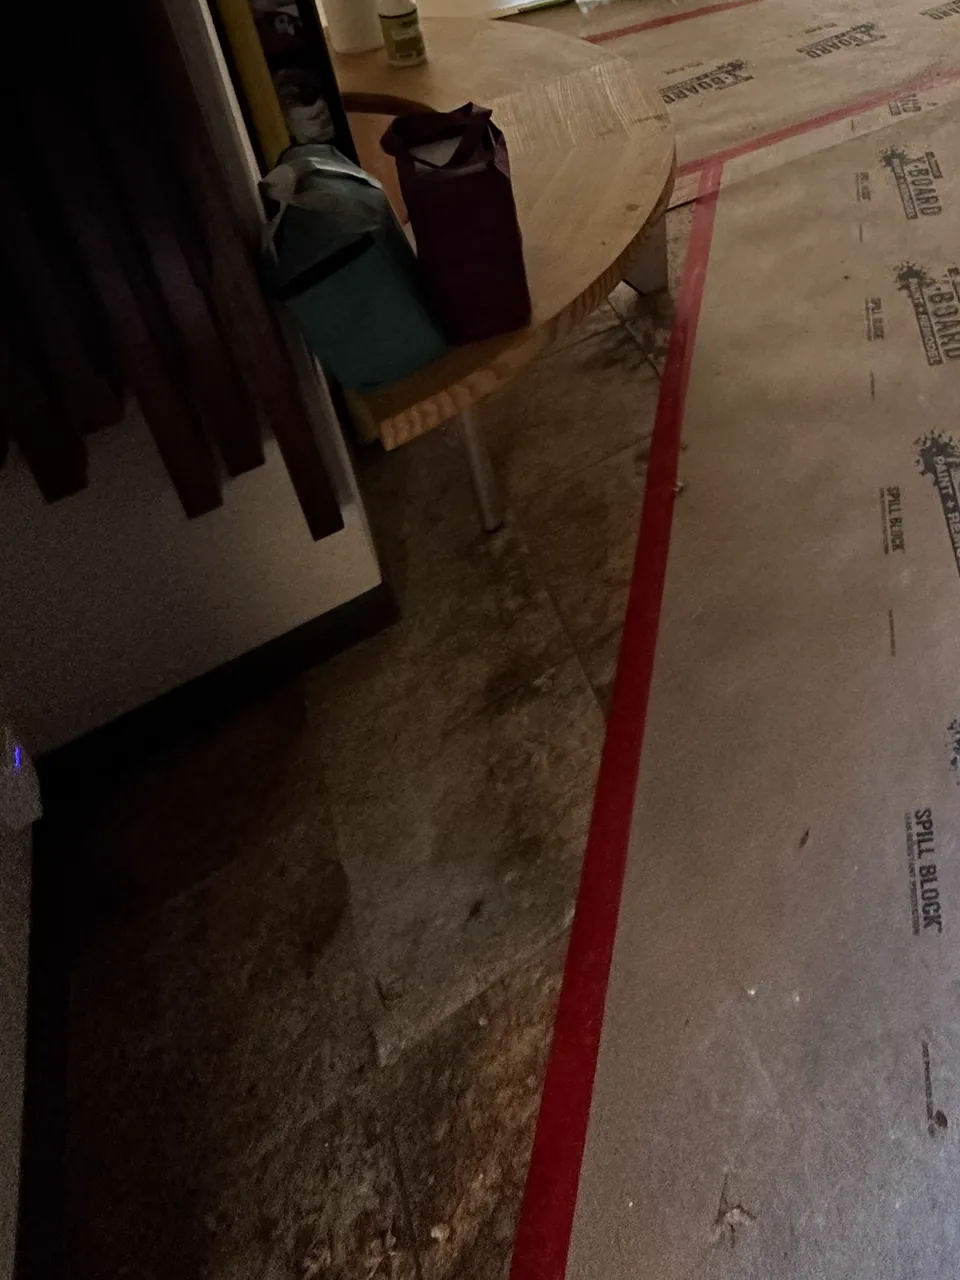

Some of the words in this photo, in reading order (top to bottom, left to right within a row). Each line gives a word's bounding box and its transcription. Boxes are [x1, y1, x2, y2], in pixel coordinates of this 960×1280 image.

[934, 456, 953, 494] PAINT
[886, 486, 901, 515] SPILL
[915, 808, 936, 859] SPILL
